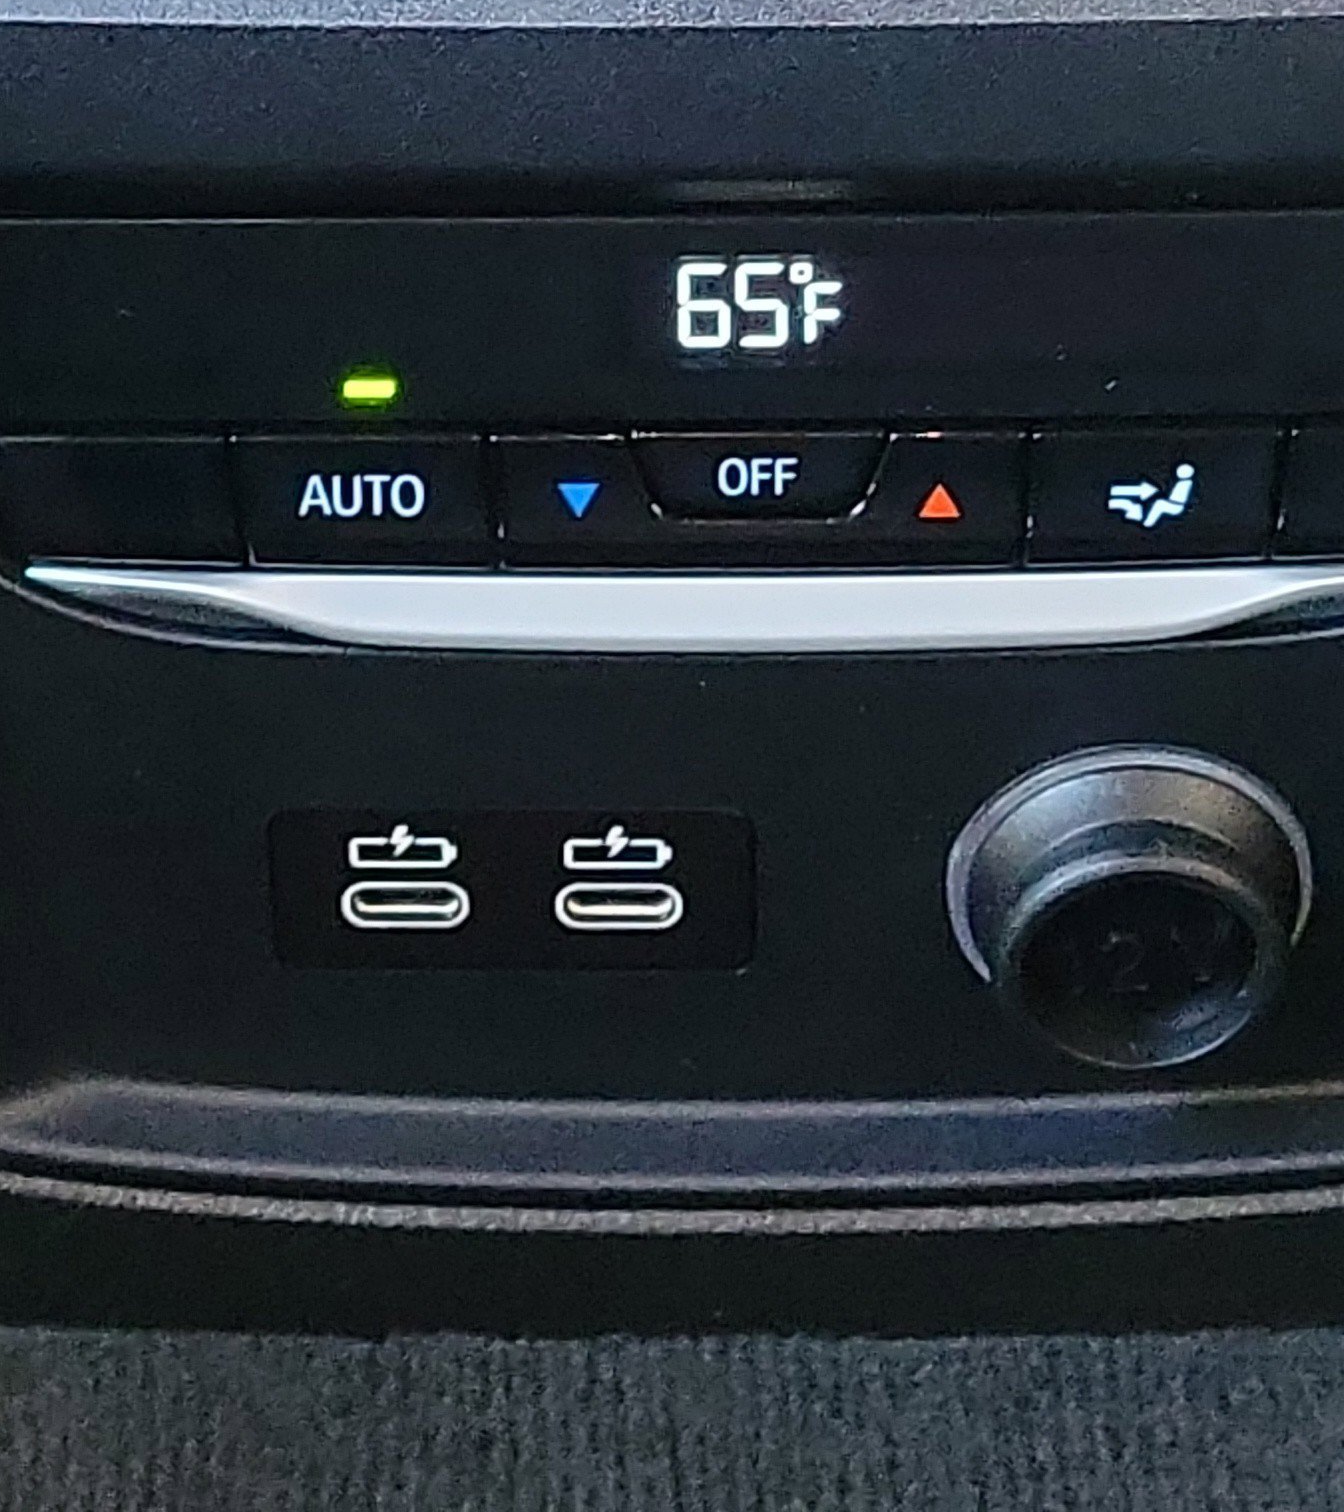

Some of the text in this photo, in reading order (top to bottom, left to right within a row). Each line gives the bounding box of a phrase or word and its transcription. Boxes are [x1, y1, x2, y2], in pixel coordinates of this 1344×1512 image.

[675, 258, 843, 350] 65°F
[297, 473, 425, 518] AUTO
[716, 456, 798, 496] OFF
